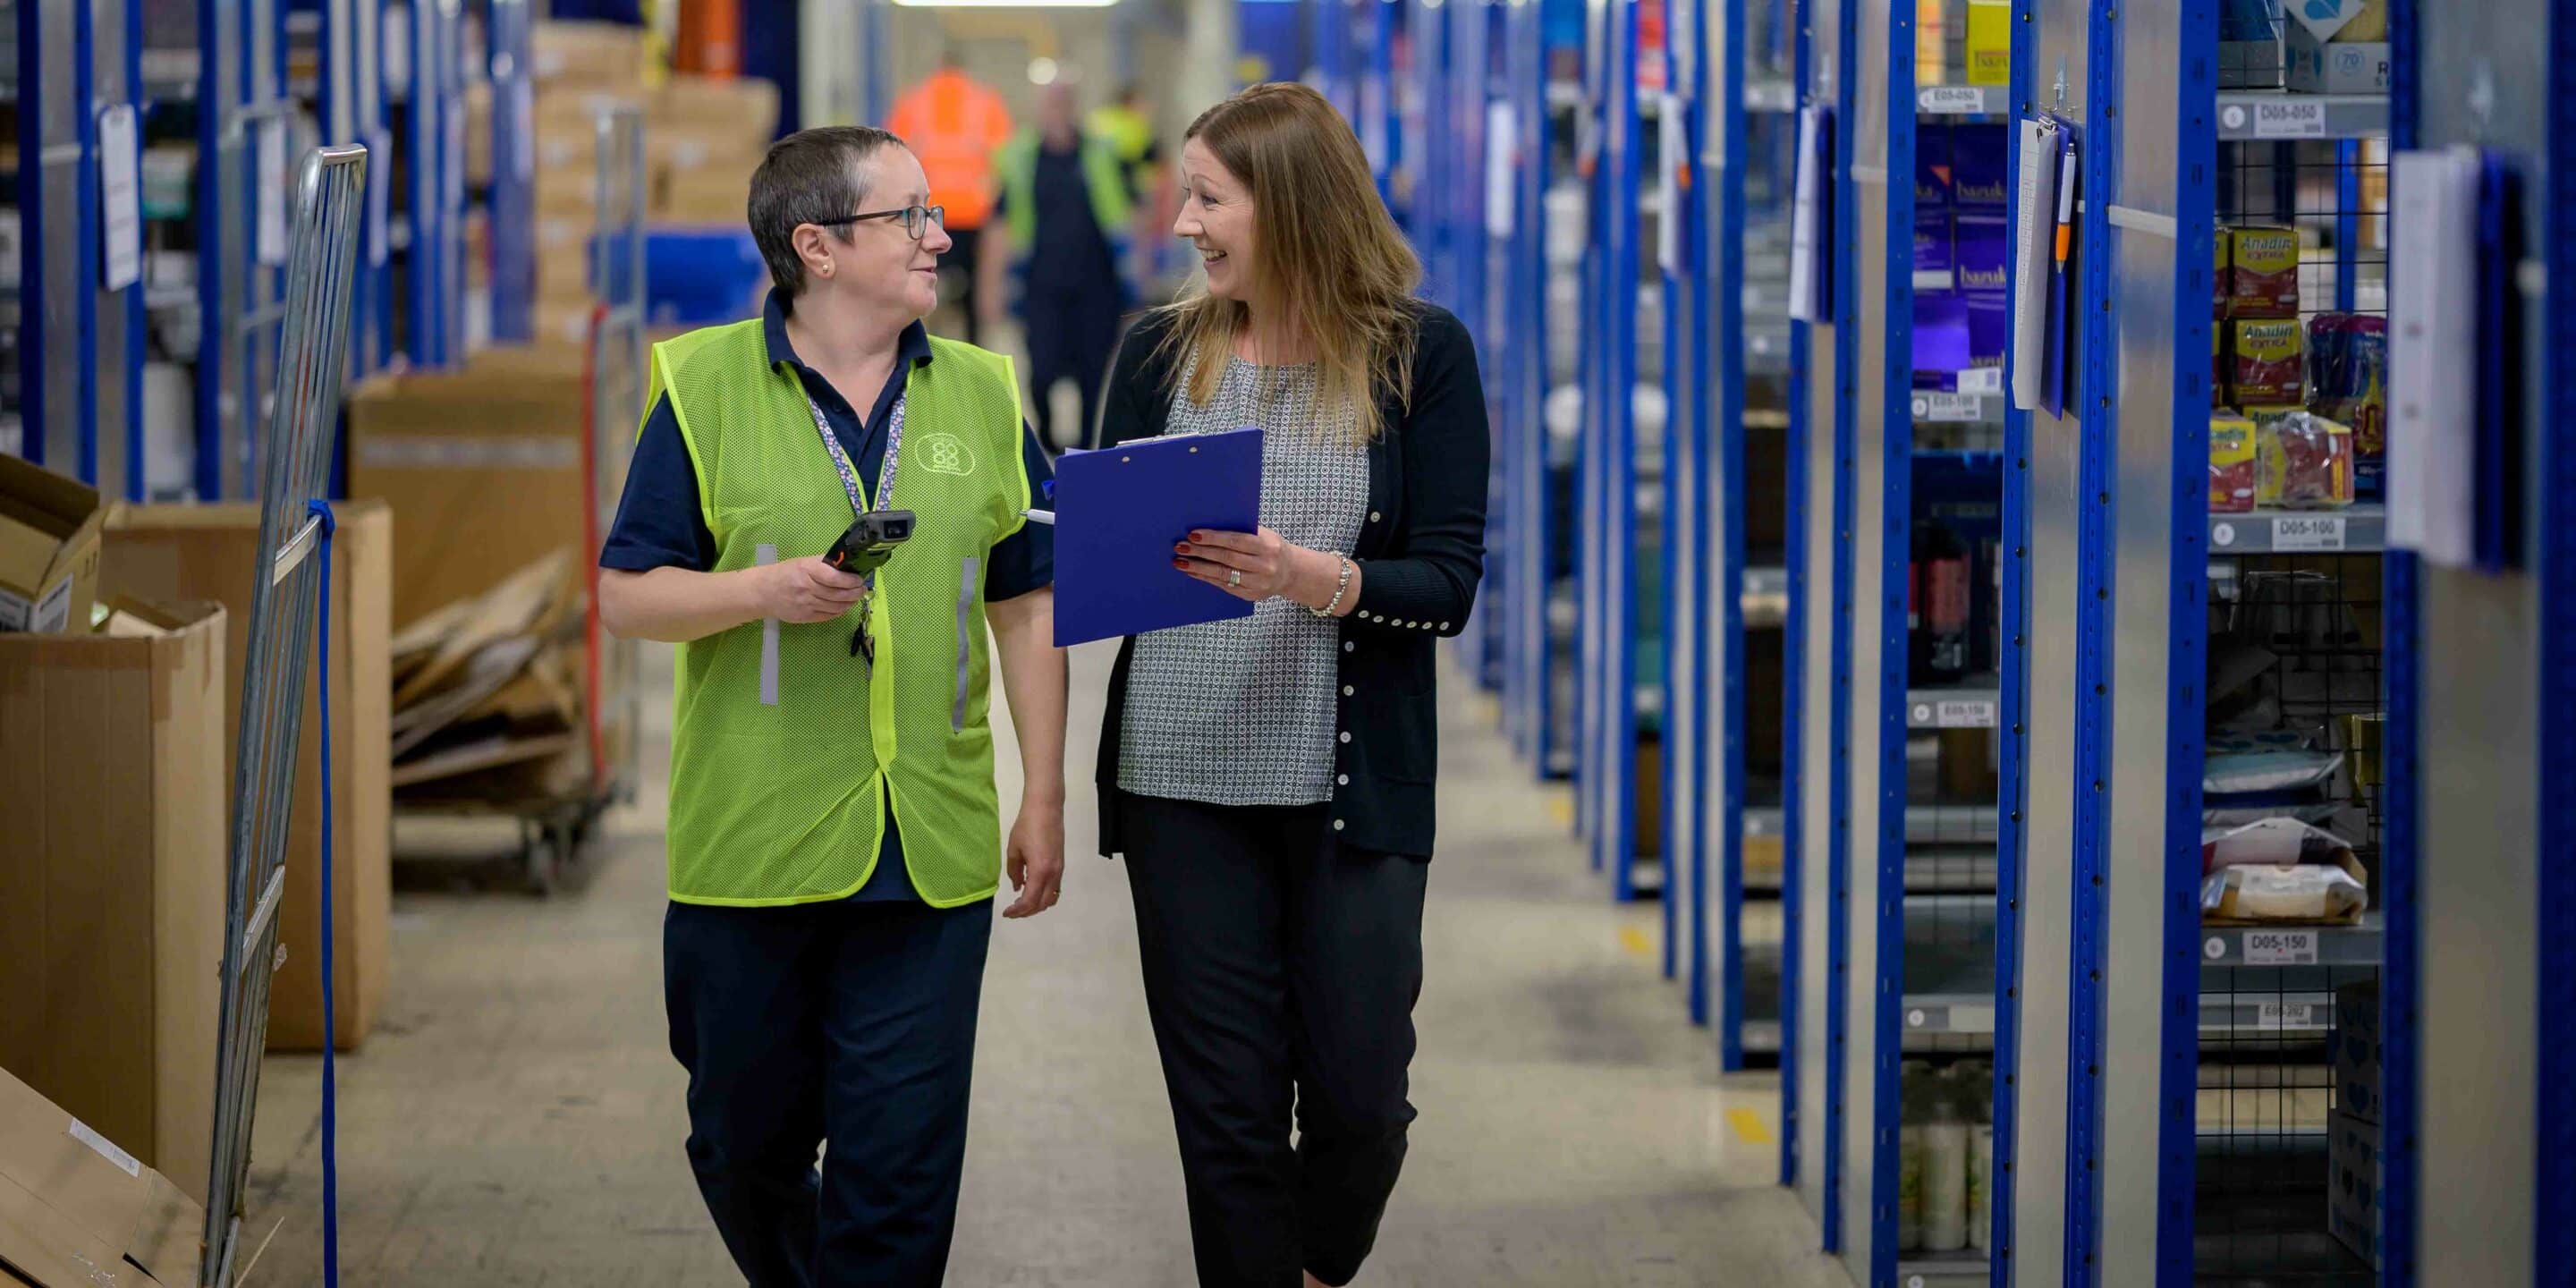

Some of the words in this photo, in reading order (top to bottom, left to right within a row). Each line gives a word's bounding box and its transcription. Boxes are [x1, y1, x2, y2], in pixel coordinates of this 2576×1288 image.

[2260, 104, 2317, 120] D05-050
[2241, 236, 2292, 250] Anadin
[2245, 324, 2293, 337] Anadin
[2280, 521, 2334, 534] D05-100
[2251, 935, 2307, 949] D05-150
